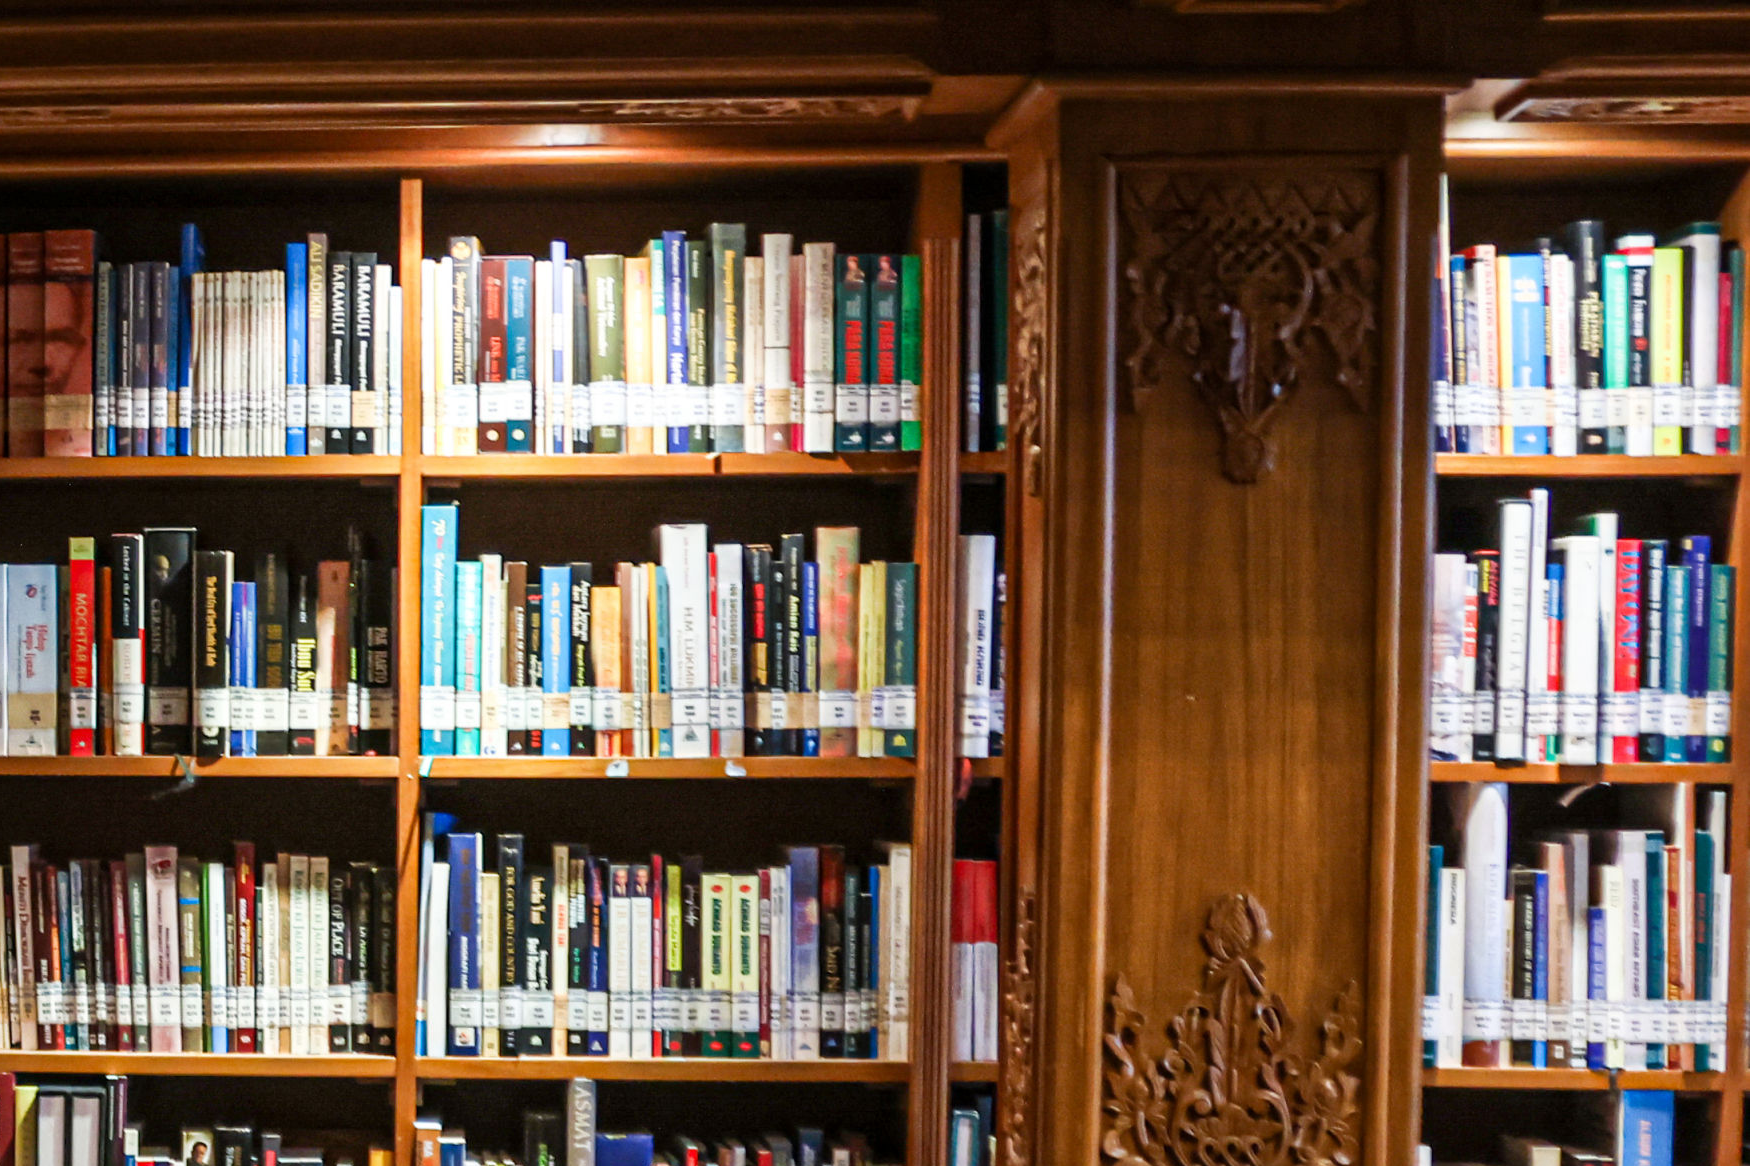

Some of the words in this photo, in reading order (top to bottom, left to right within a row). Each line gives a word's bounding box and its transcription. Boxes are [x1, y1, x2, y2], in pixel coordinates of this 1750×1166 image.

[310, 240, 322, 263] ALI
[310, 264, 322, 319] SADIKIN
[332, 264, 346, 335] BARAMULI
[357, 265, 371, 337] BARAMULI
[122, 545, 132, 572] Locked
[788, 595, 800, 629] Amien
[36, 624, 49, 653] Hidup
[74, 593, 88, 662] MOCHTAR
[788, 630, 800, 654] Rais
[296, 638, 317, 669] Ibnu
[74, 665, 88, 688] RIA
[331, 878, 345, 903] OUT
[505, 866, 516, 887] FOR
[331, 904, 345, 919] OF
[505, 887, 516, 912] GOD
[331, 920, 345, 957] PLACE
[505, 912, 516, 935] AND
[505, 935, 516, 983] COUNTRY
[574, 1086, 593, 1153] ASMAT
[1638, 1120, 1652, 1157] ALBUM
